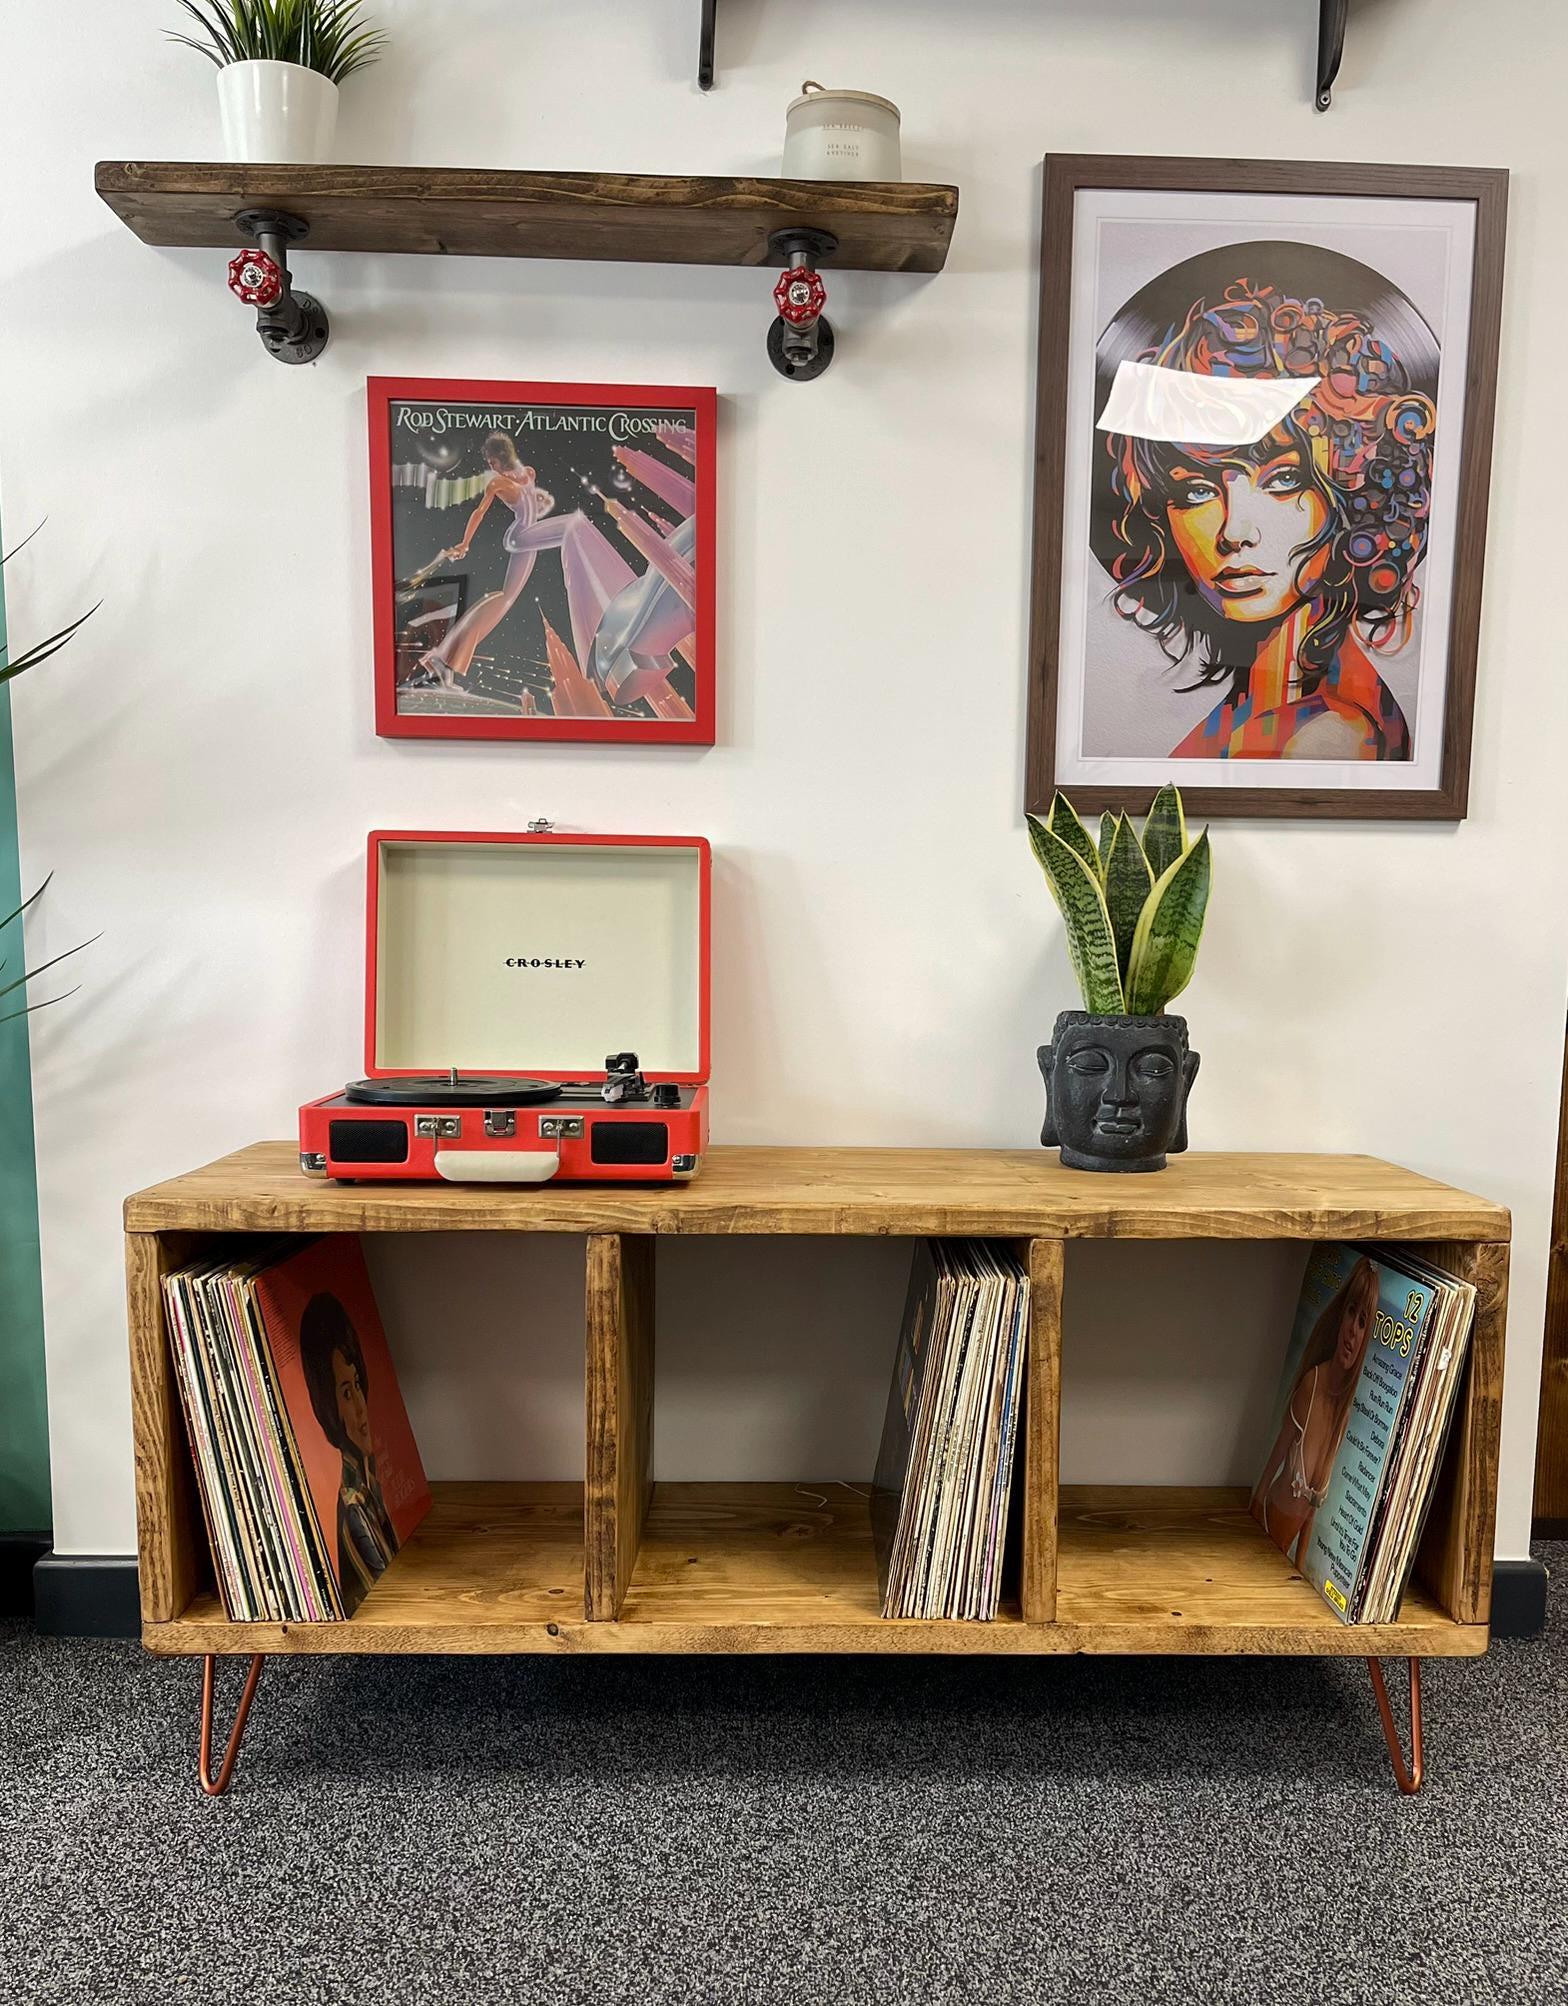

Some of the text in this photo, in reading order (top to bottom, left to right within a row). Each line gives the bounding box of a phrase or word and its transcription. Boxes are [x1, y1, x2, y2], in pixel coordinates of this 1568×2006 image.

[503, 958, 586, 969] CROSLEY
[1404, 1291, 1423, 1324] 12
[1373, 1310, 1414, 1358] TOPS
